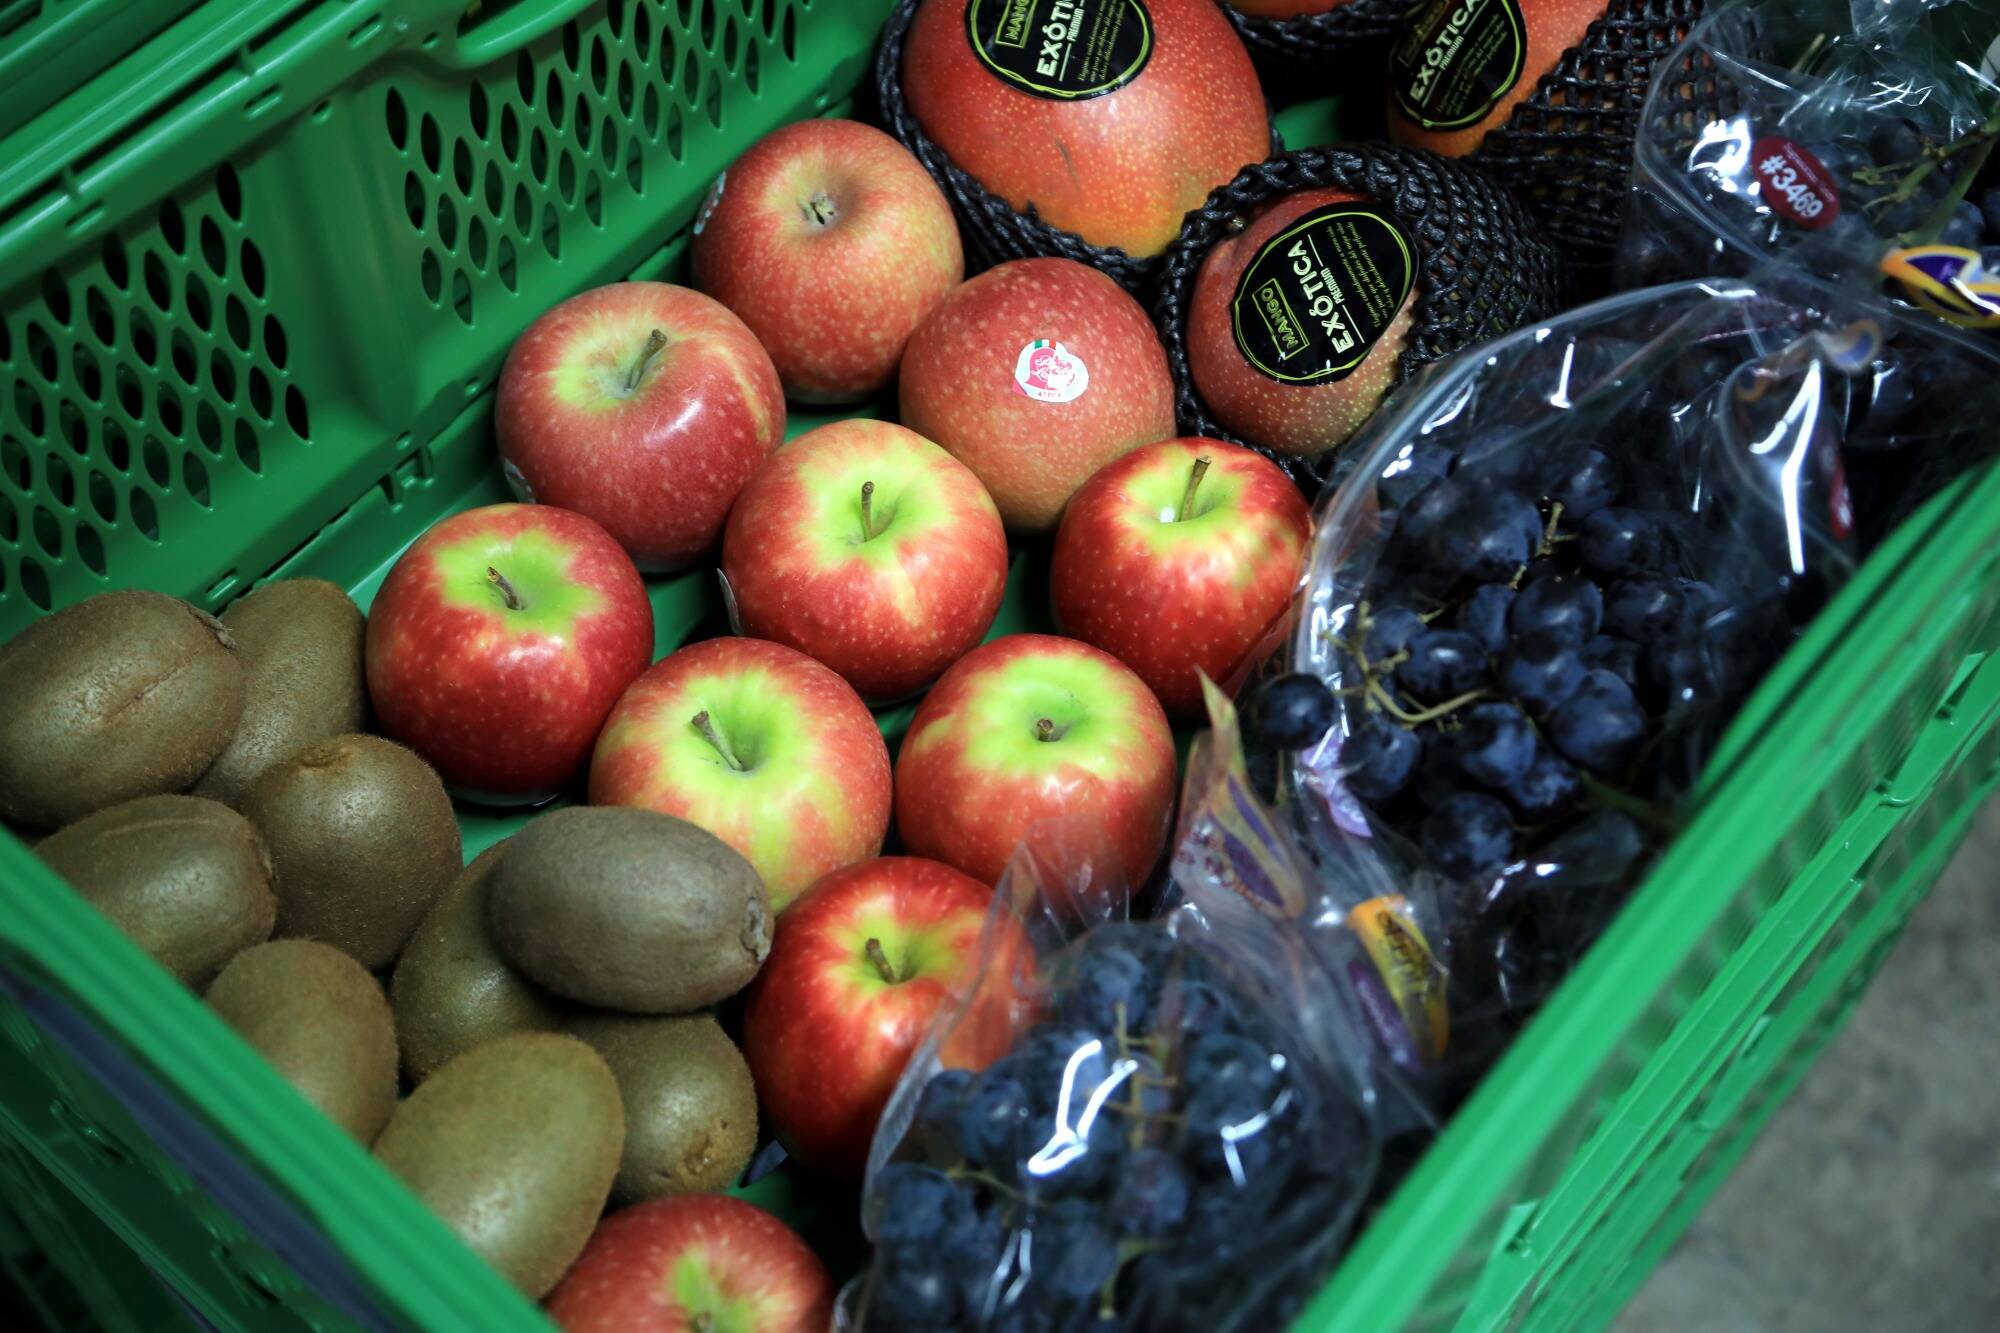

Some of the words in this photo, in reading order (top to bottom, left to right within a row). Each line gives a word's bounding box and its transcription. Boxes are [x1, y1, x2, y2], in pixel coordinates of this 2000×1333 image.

[1036, 0, 1075, 77] EXÓTI
[1067, 8, 1085, 42] PREMIUM
[1439, 36, 1464, 70] PREMIUM
[1760, 155, 1823, 218] #3469
[1288, 240, 1355, 354] EXÓTICA
[1320, 267, 1345, 305] PREMIUM
[1261, 287, 1298, 349] MANGO
